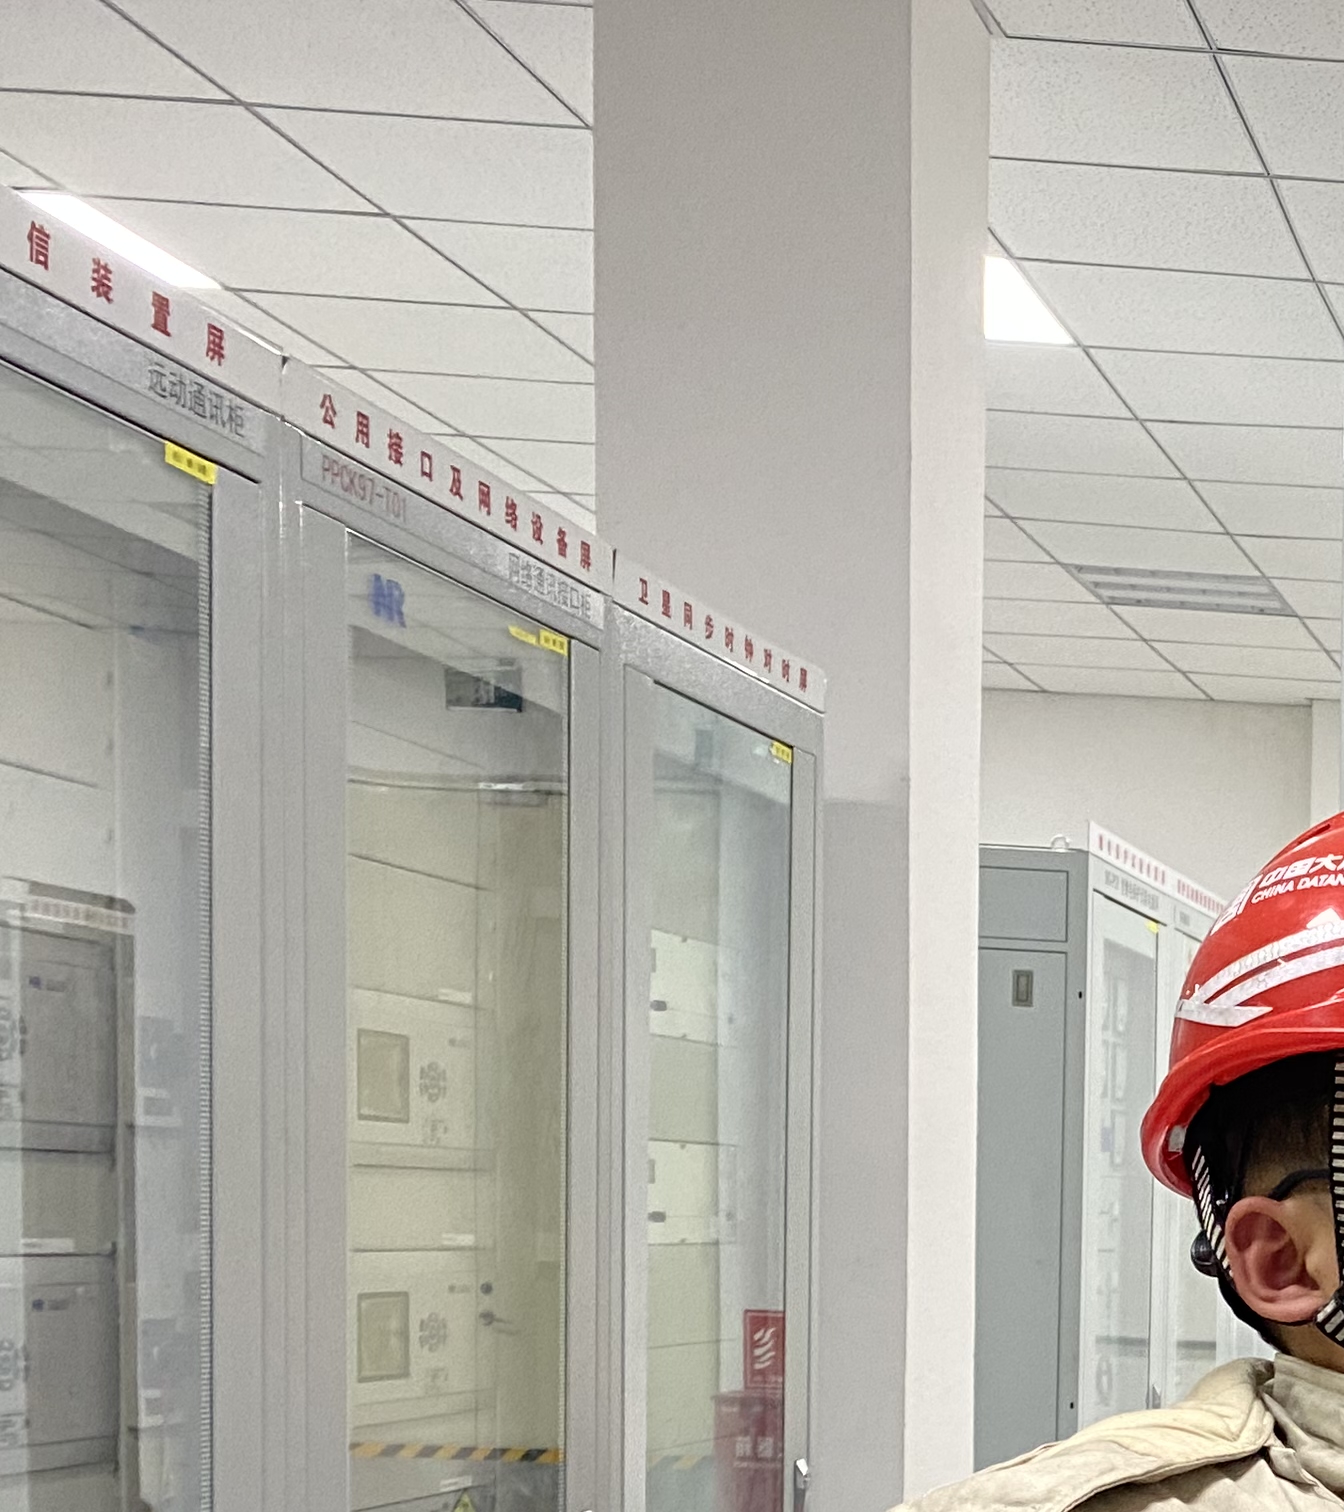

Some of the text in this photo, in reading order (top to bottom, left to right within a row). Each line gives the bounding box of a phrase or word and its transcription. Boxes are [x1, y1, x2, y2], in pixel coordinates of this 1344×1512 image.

[27, 220, 226, 367] 信装置屏
[148, 363, 246, 439] 远动通讯柜
[319, 393, 592, 573] 公用接口及网络设备屏
[638, 577, 808, 693] 卫星同步时钟对时屏
[1251, 880, 1295, 904] CHINA
